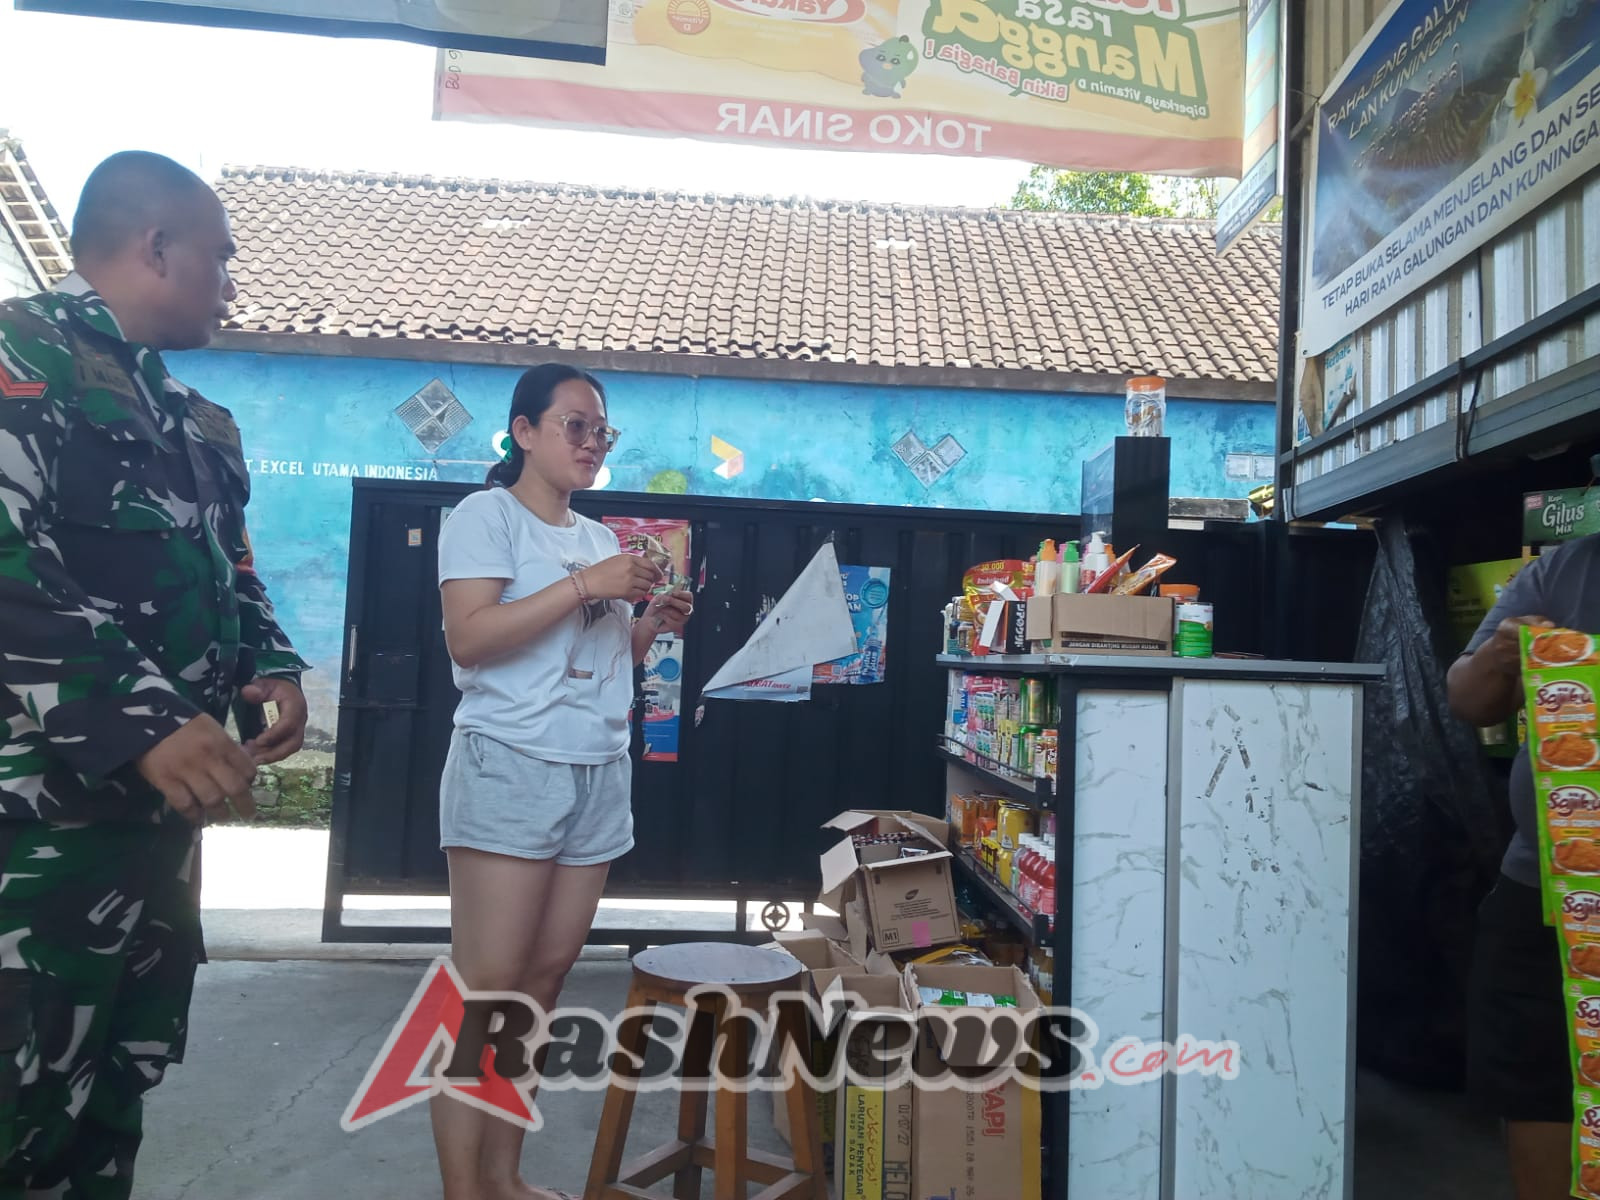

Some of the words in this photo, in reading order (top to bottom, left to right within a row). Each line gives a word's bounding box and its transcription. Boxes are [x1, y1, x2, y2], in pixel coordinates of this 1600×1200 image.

[1327, 42, 1408, 129] RAHAJENG
[1349, 103, 1379, 140] LAN
[1380, 2, 1469, 113] KUNINGAN
[1322, 278, 1354, 311] TETAP
[1354, 257, 1384, 289] BUKA
[1385, 219, 1432, 266] SELAMA
[1433, 141, 1528, 222] MENJELANG
[1531, 106, 1572, 154] DAN
[1344, 290, 1370, 317] HARI
[1369, 268, 1402, 297] RAYA
[1403, 213, 1475, 276] GALUNGAN
[1477, 183, 1513, 225] DAN
[260, 460, 305, 476] EXCEL
[313, 462, 360, 478] UTAMA
[364, 464, 438, 481] INDONESIA
[1542, 503, 1585, 528] Gilus
[1554, 523, 1573, 537] Mix
[884, 932, 898, 941] M1
[856, 1094, 866, 1139] LARUTAN
[855, 1143, 866, 1195] PENYEGAR
